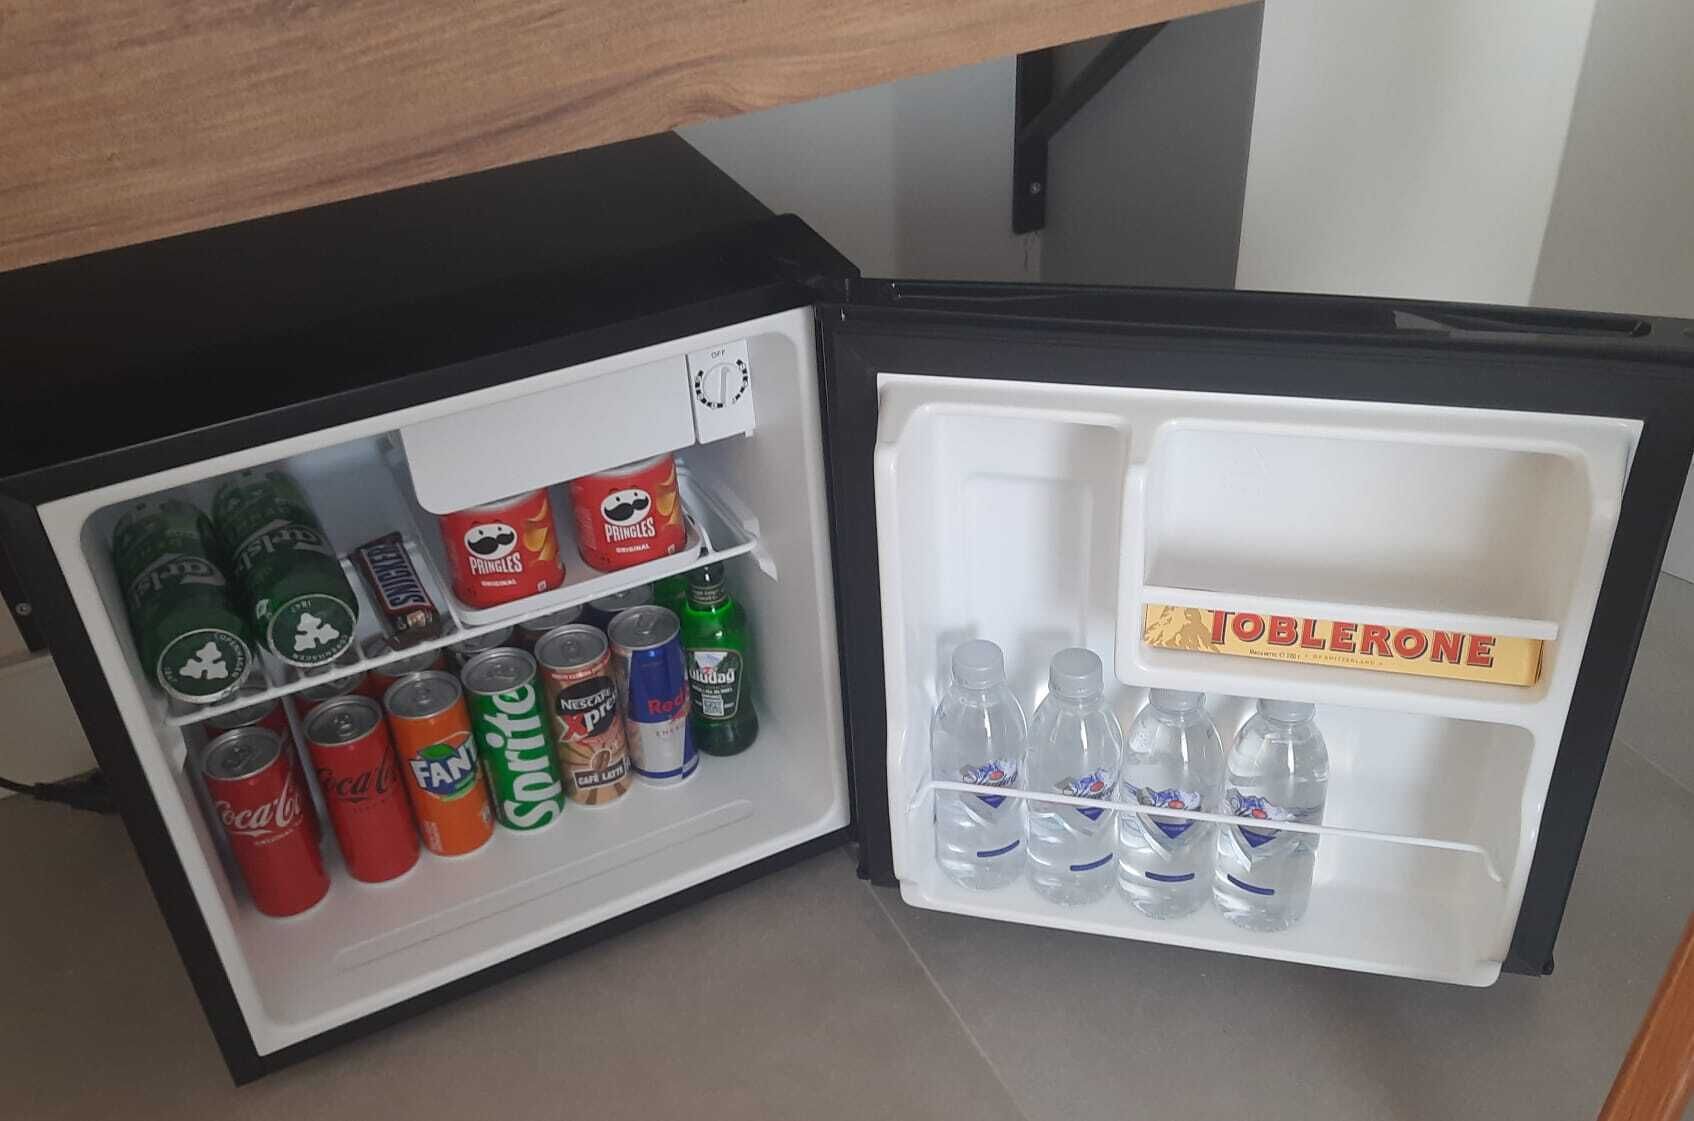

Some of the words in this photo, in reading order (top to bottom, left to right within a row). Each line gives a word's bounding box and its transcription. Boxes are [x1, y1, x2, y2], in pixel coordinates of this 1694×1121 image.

[710, 349, 726, 359] OFF
[604, 518, 656, 543] PRINGLES
[470, 552, 523, 576] PRINGLES
[1207, 609, 1496, 667] TOBLERONE
[648, 687, 690, 715] Red
[483, 684, 562, 828] Sprite
